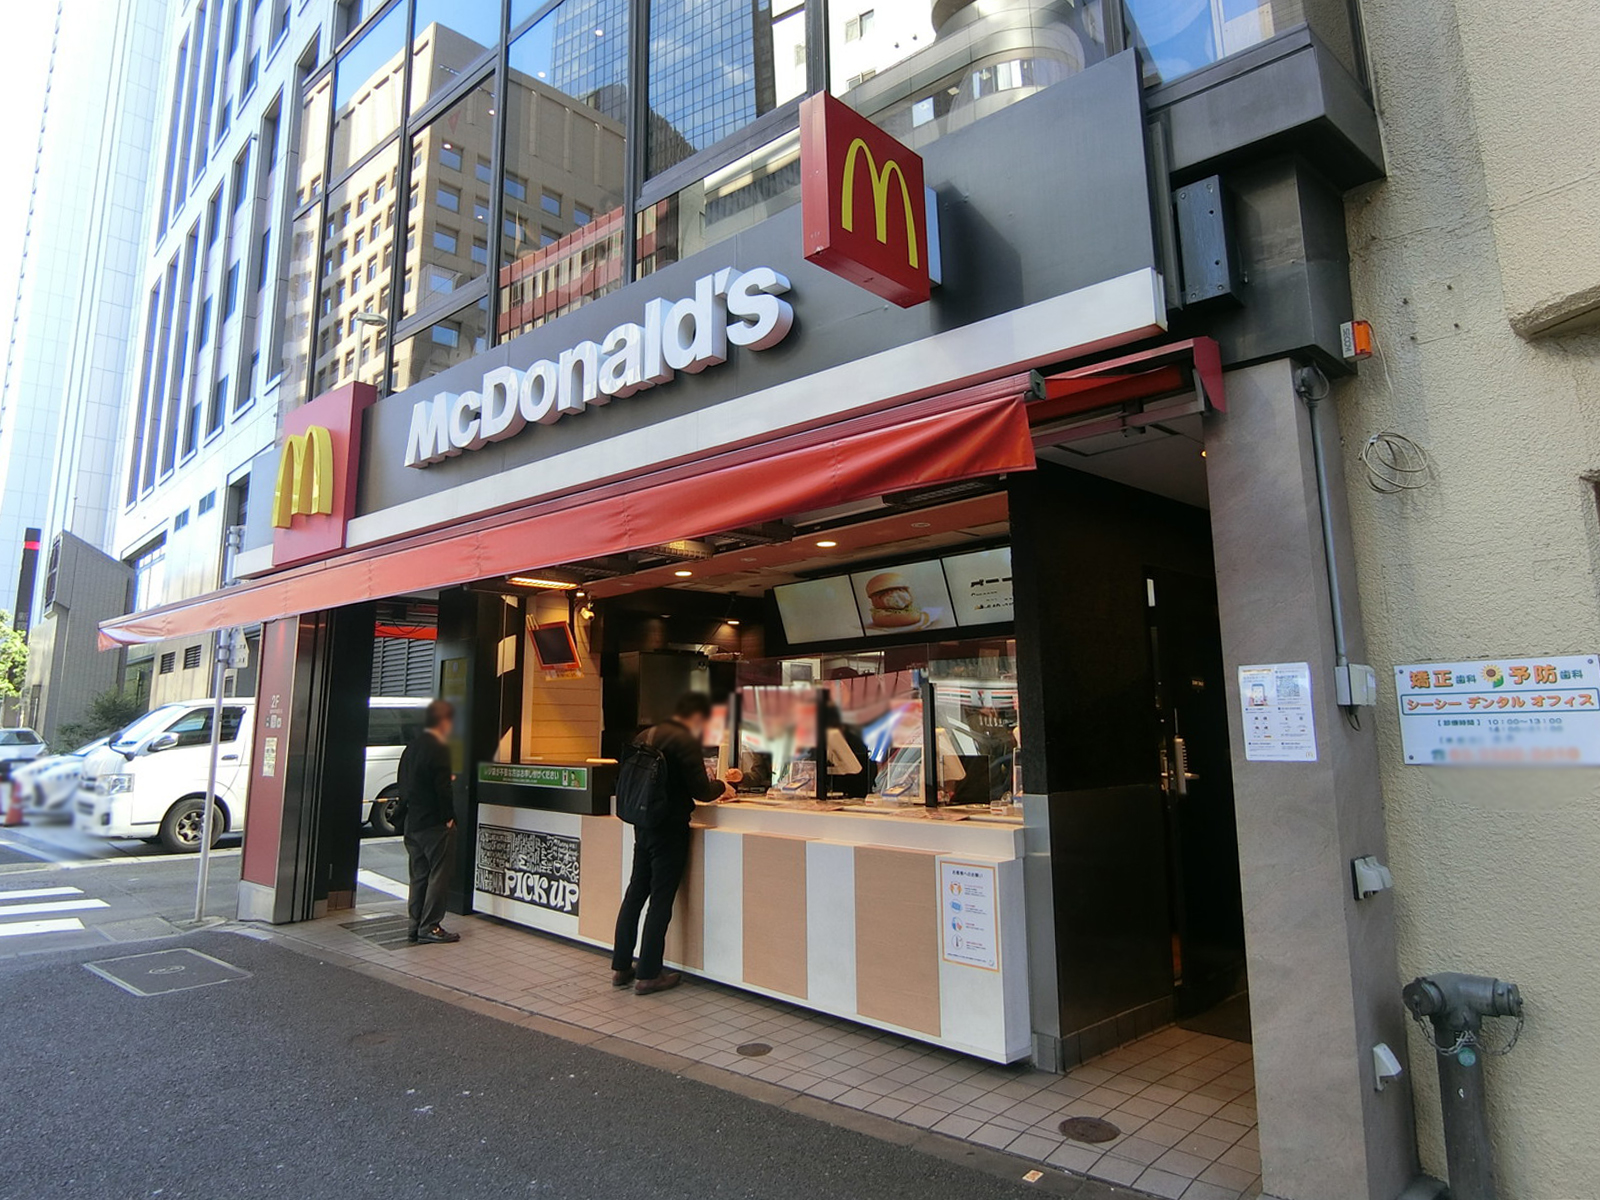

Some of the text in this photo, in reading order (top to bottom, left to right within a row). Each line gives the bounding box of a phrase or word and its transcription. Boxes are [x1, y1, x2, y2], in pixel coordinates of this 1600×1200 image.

[1343, 328, 1352, 352] SECOM
[404, 266, 794, 469] McDonald's
[1406, 693, 1595, 711] シーシー デンタル オフィス
[504, 868, 549, 904] PICK
[549, 879, 579, 912] UP
